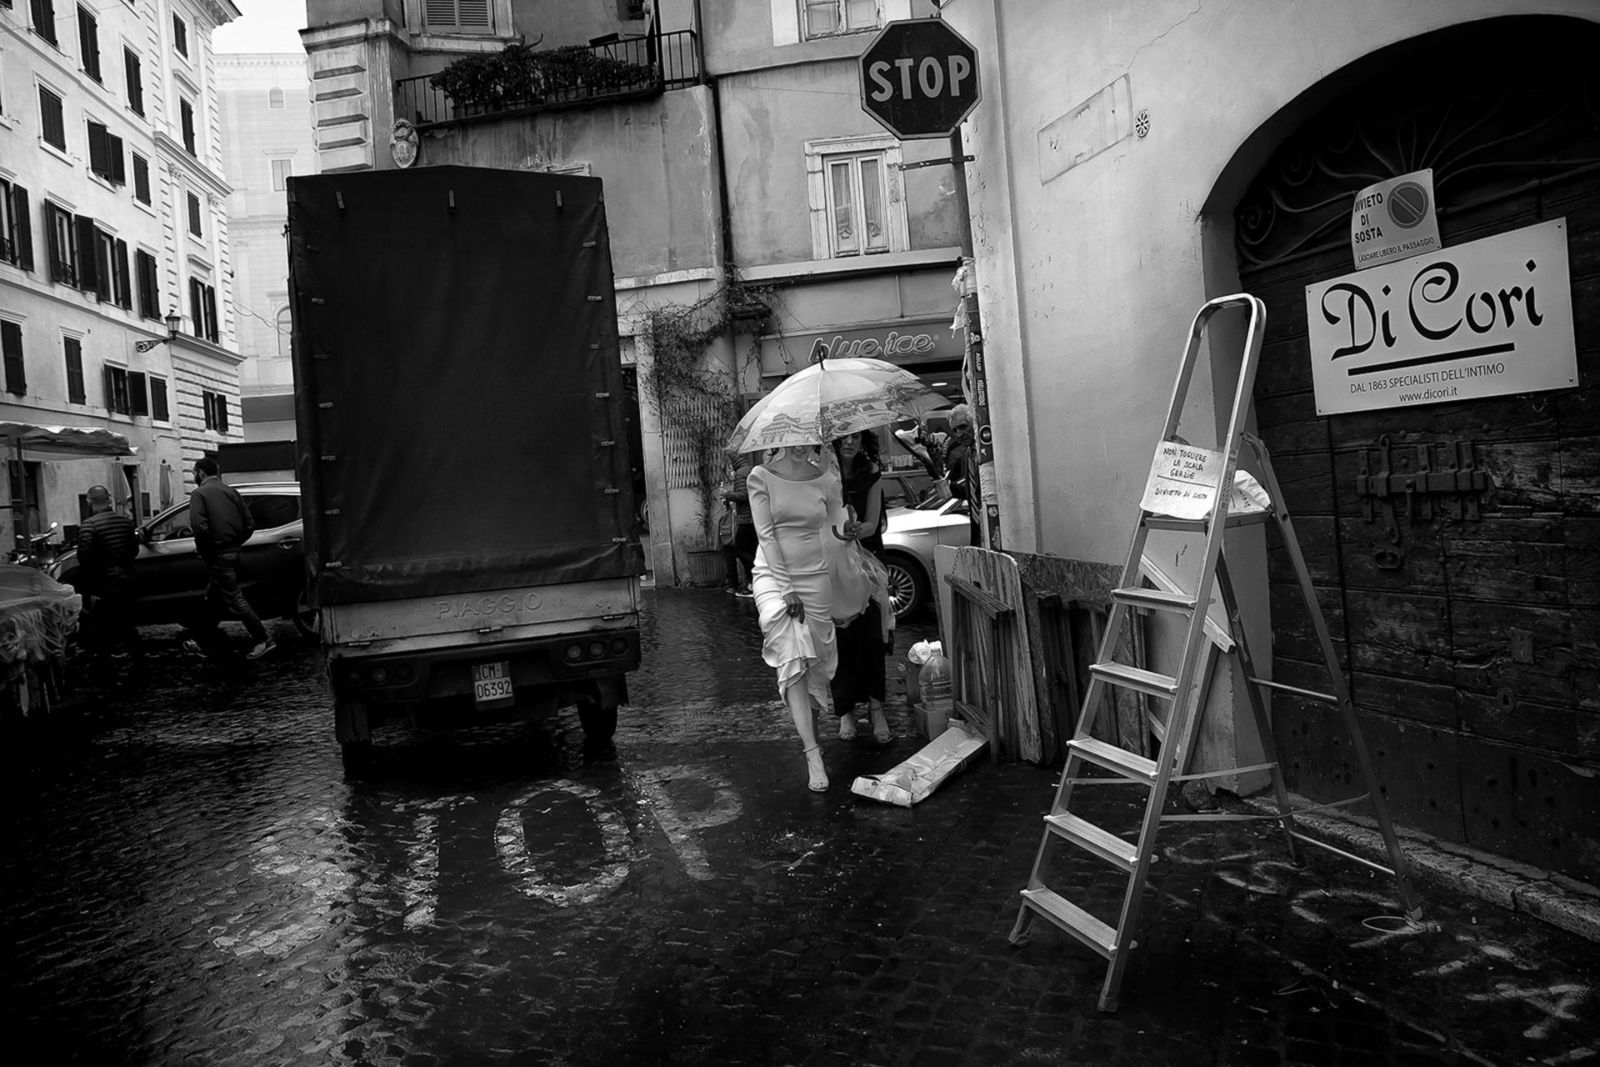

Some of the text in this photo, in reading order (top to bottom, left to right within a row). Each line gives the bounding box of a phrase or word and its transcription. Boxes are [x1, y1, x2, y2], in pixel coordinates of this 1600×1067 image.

[869, 55, 971, 102] STOP
[1354, 192, 1384, 213] DIVIETO
[1360, 213, 1370, 226] DI
[1354, 226, 1383, 244] SOSTA
[1358, 250, 1380, 263] LASCIARE
[1380, 246, 1397, 258] LIBERO
[1403, 236, 1435, 251] PASSAGGIO
[1321, 258, 1544, 362] Di Cori
[808, 331, 936, 363] blue ice
[1350, 362, 1505, 394] DAL 1863 SPECIALISTI DELL'INTIMO
[1399, 386, 1458, 402] www.dicori.it
[1163, 447, 1178, 457] NON
[1170, 468, 1195, 480] GRAZIE
[1173, 459, 1204, 472] LA SCALA
[1154, 487, 1182, 497] DIVIETO
[432, 592, 543, 620] PIAGGIO
[481, 663, 497, 680] CM
[476, 680, 513, 698] 06392
